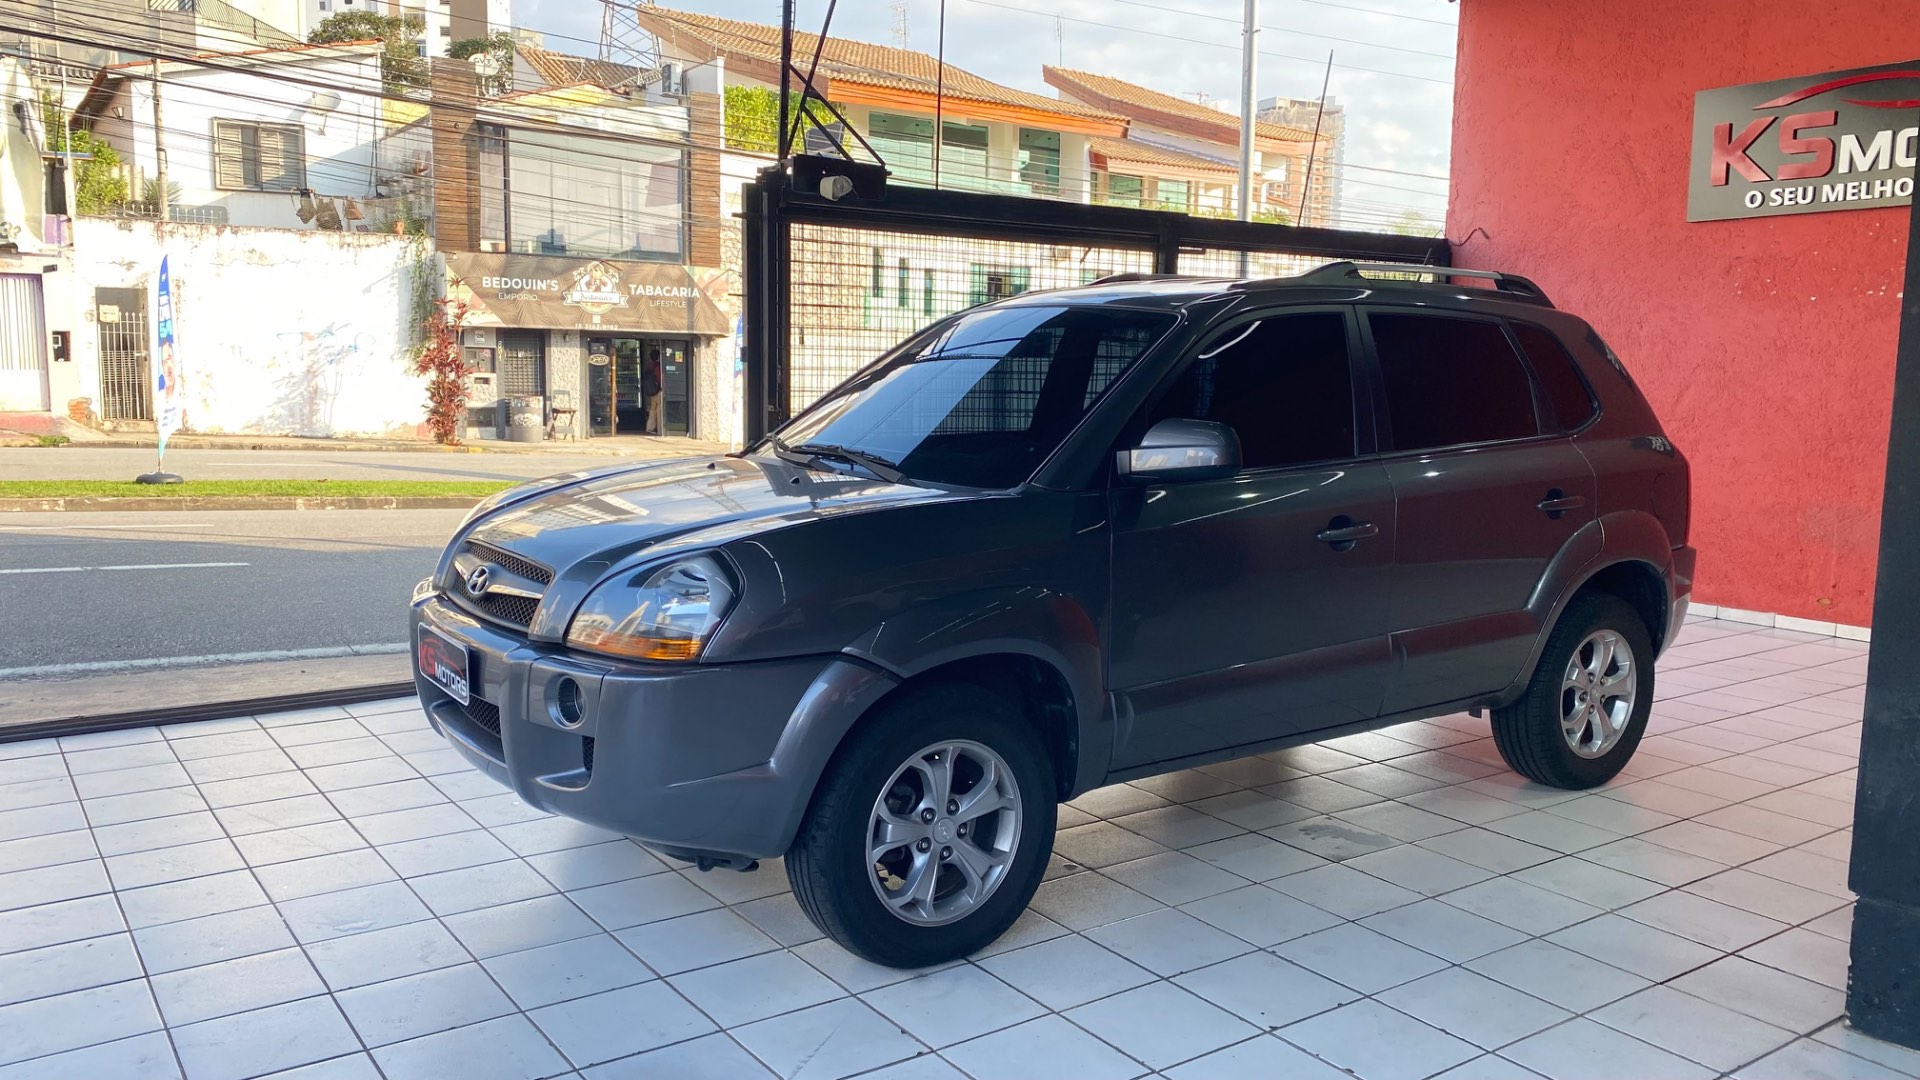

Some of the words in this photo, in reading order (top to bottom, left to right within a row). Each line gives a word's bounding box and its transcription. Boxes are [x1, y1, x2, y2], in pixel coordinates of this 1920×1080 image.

[1710, 110, 1838, 187] KS
[1744, 190, 1764, 209] O
[1769, 186, 1815, 207] SEU
[1821, 177, 1914, 203] MELHO
[482, 276, 559, 291] BEDOUIN'S
[629, 284, 700, 298] TABACARIA
[649, 300, 687, 309] LIFESTYLE
[590, 355, 609, 364] OPEN
[421, 643, 436, 677] KS
[435, 661, 467, 696] MOTORS
